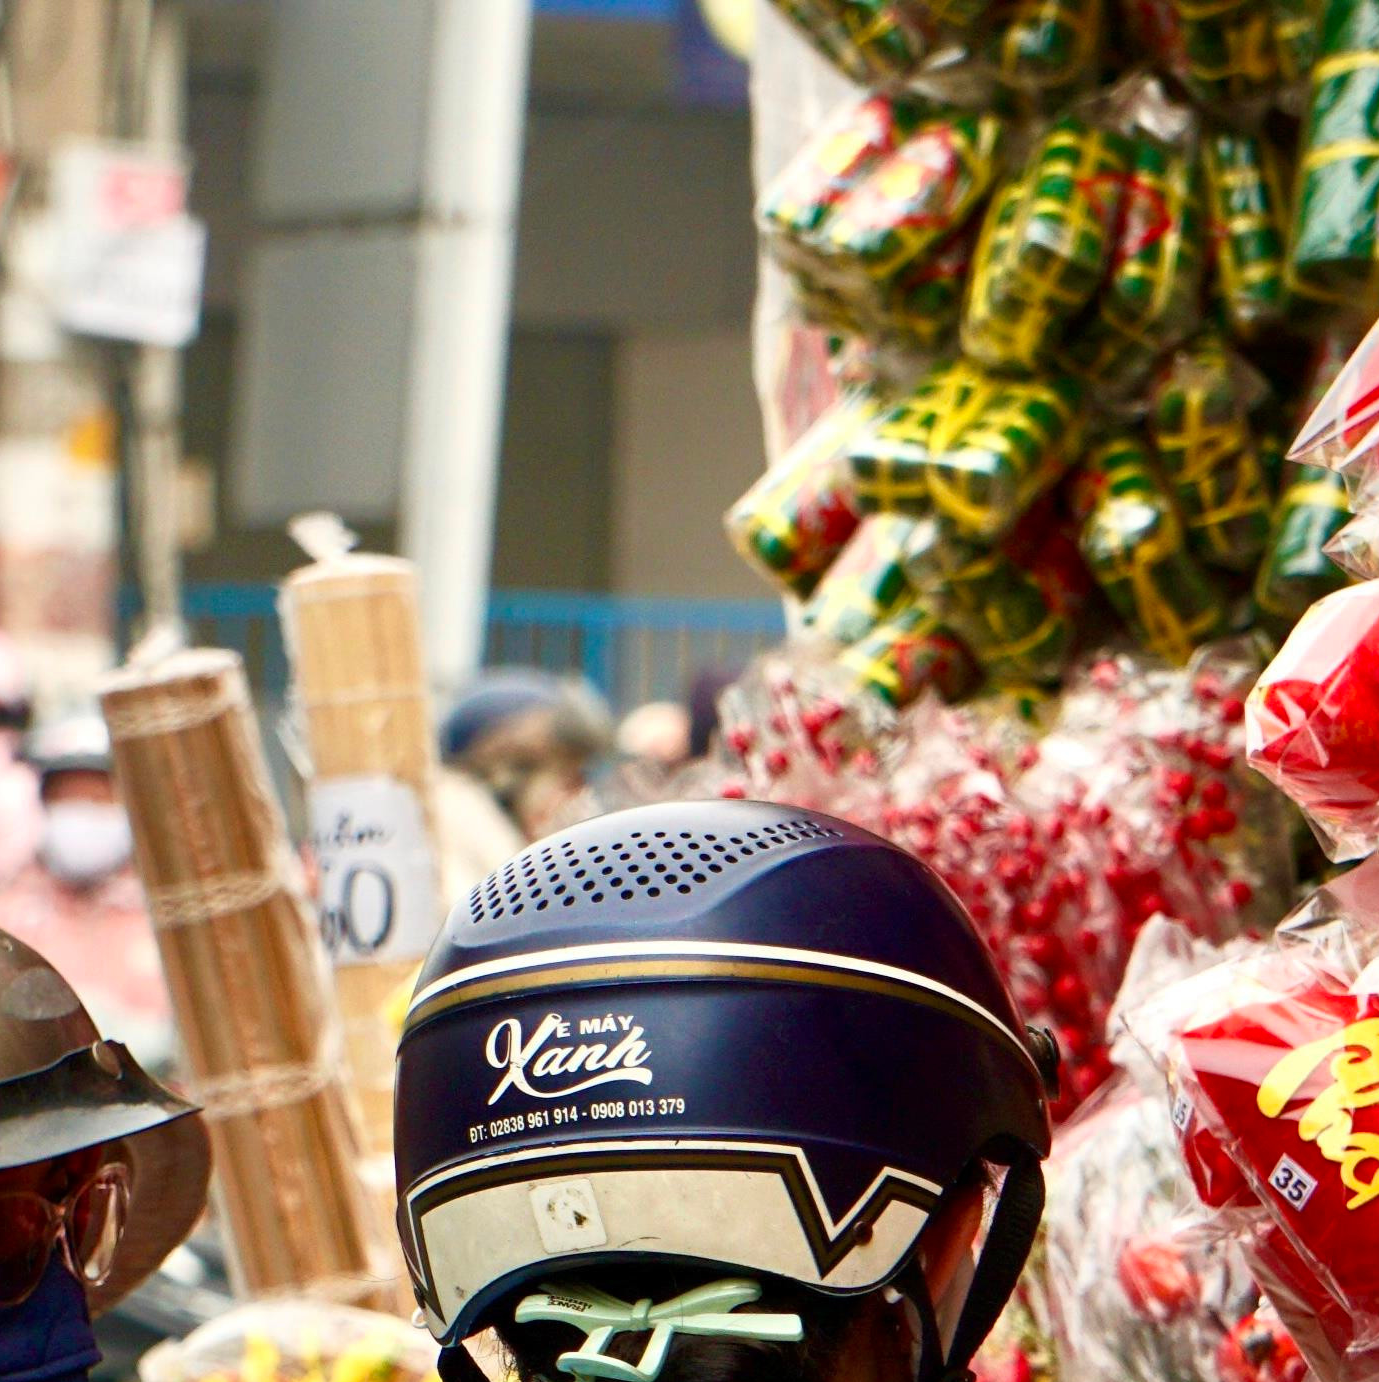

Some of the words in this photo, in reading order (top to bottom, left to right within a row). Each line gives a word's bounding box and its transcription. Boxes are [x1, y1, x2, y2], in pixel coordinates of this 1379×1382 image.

[580, 1013, 634, 1035] MÁY
[486, 1013, 653, 1105] Xanh
[490, 1115, 525, 1138] 02838
[528, 1110, 549, 1129] 961
[554, 1106, 578, 1124] 914
[591, 1102, 625, 1120] 0908
[629, 1100, 655, 1117] 013
[659, 1098, 686, 1115] 379
[1275, 1168, 1307, 1202] 35
